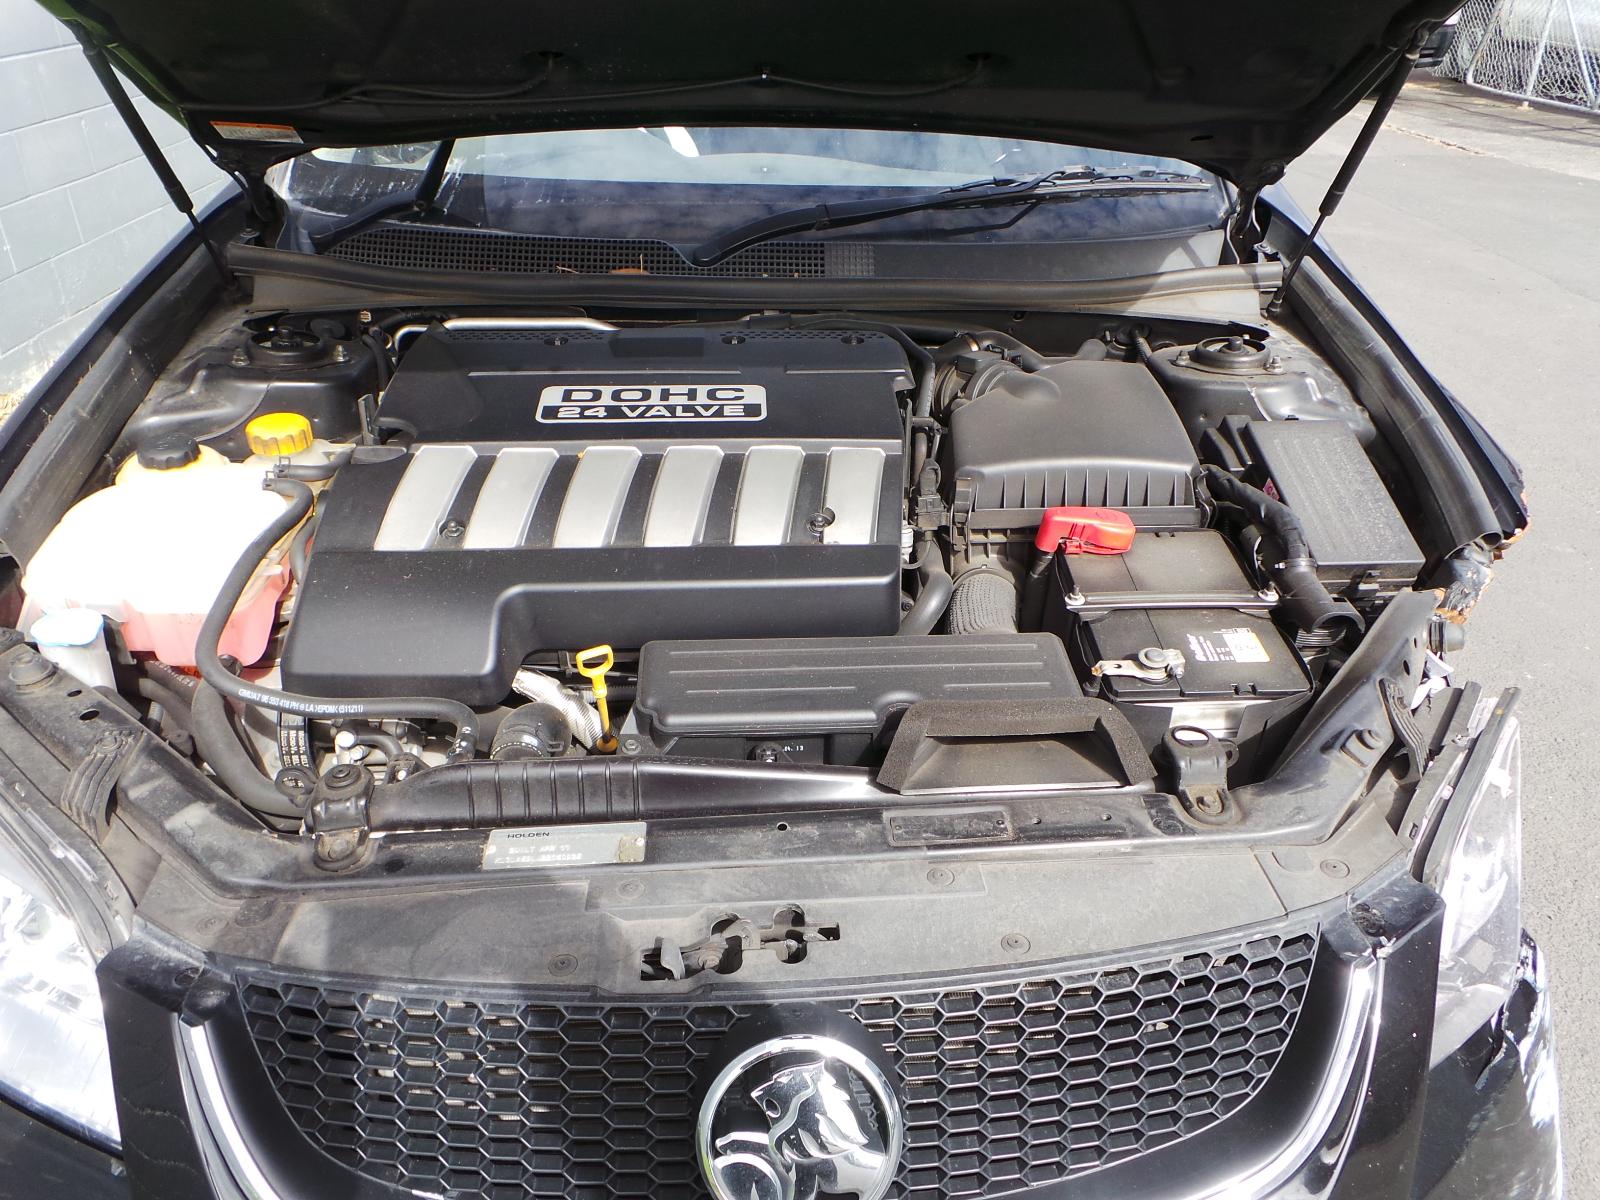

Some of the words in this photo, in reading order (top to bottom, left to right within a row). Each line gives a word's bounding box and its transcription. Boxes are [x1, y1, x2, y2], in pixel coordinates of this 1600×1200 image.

[561, 387, 745, 402] DOHC
[557, 406, 607, 418] 24
[620, 405, 745, 418] VALVE
[507, 831, 551, 839] HOLDEN
